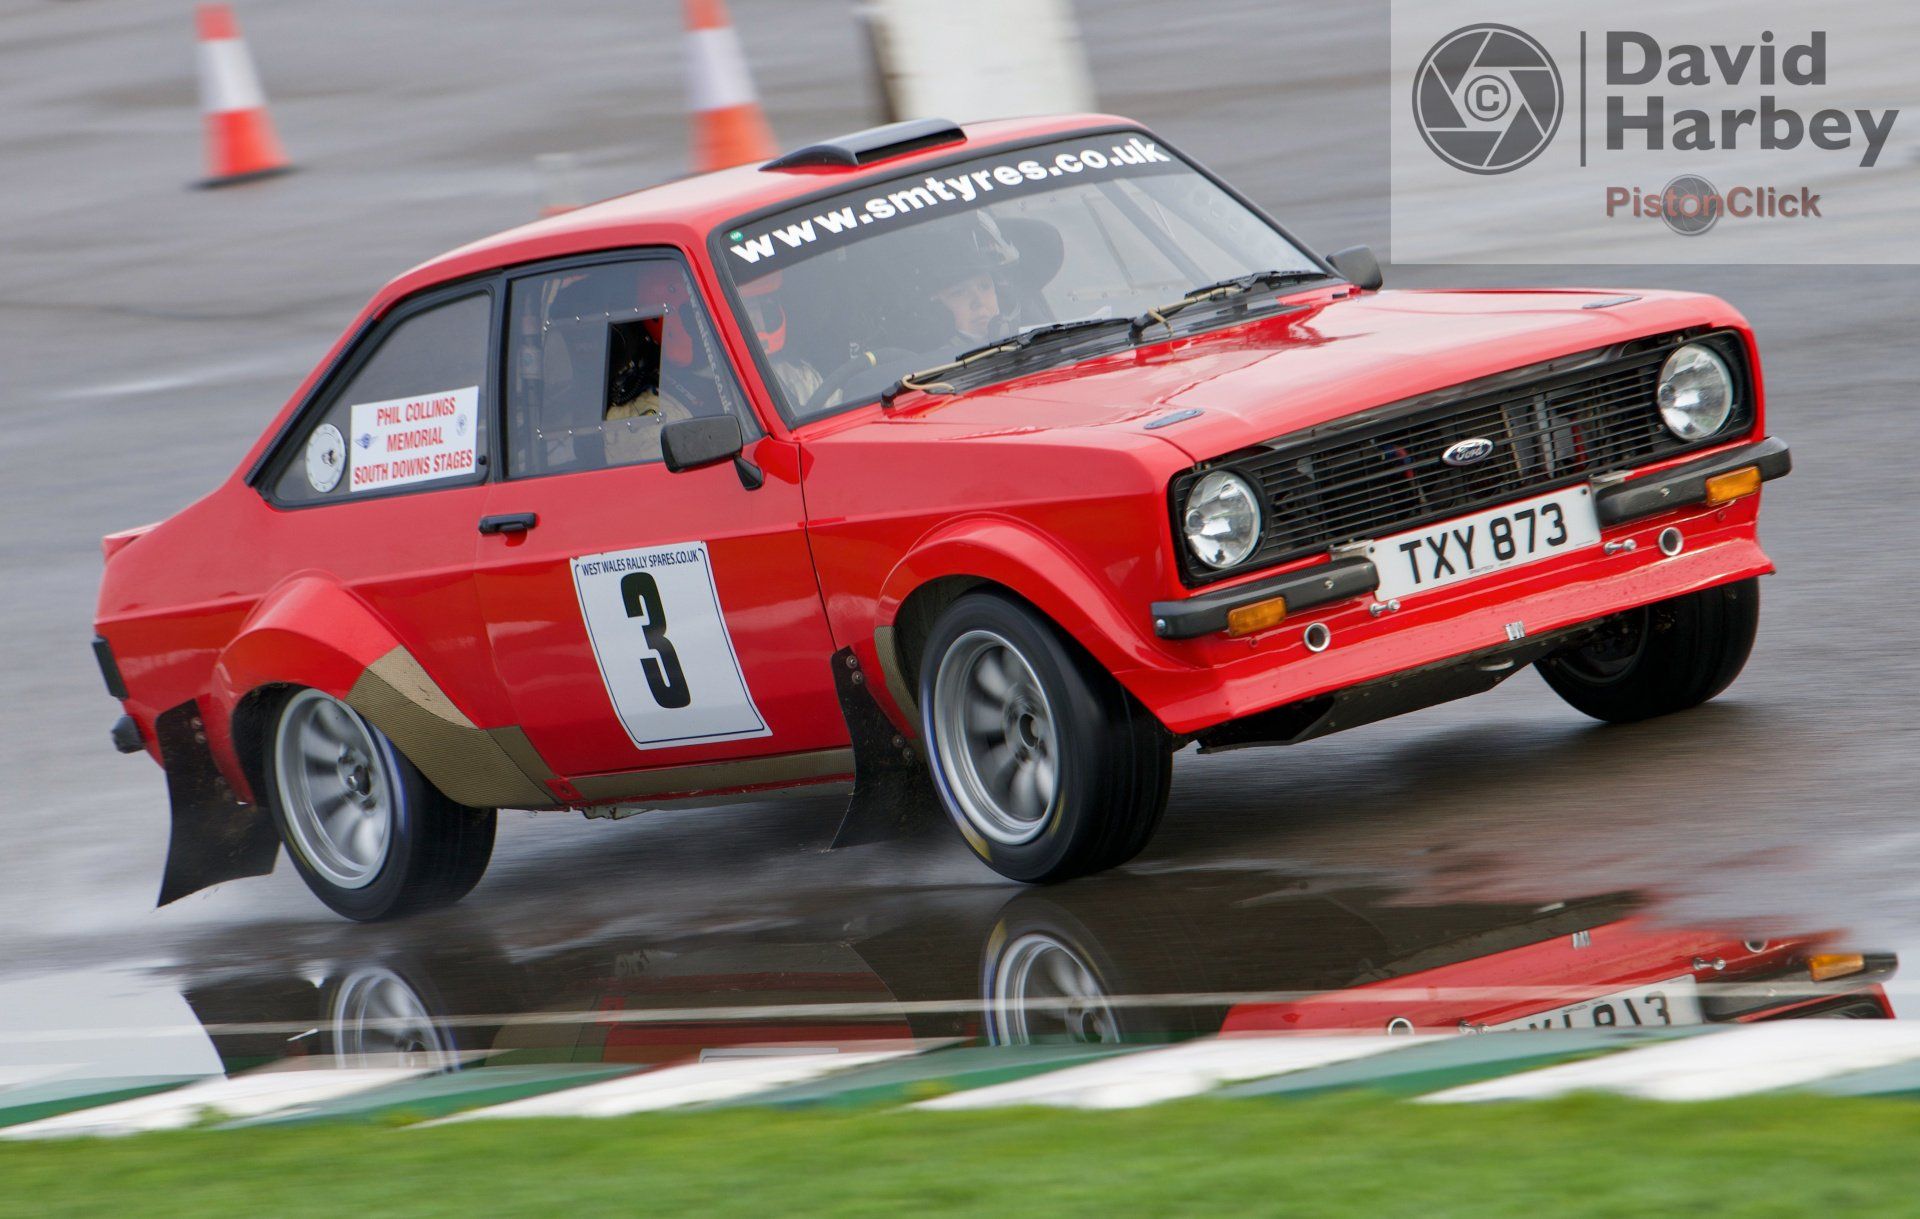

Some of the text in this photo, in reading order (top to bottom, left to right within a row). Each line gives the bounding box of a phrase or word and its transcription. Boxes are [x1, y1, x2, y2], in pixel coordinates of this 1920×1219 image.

[730, 137, 1171, 265] www.smtyres.co.uk
[377, 396, 456, 427] PHIL COLLINGS
[386, 426, 444, 453] MEMORIAL
[1455, 441, 1484, 461] Ford
[353, 448, 473, 486] SOUTH DOWNS STAGES
[1399, 502, 1568, 584] TXY 873
[581, 549, 700, 576] WEST WALES RALLY SPARES.CO.UK
[620, 571, 691, 709] 3
